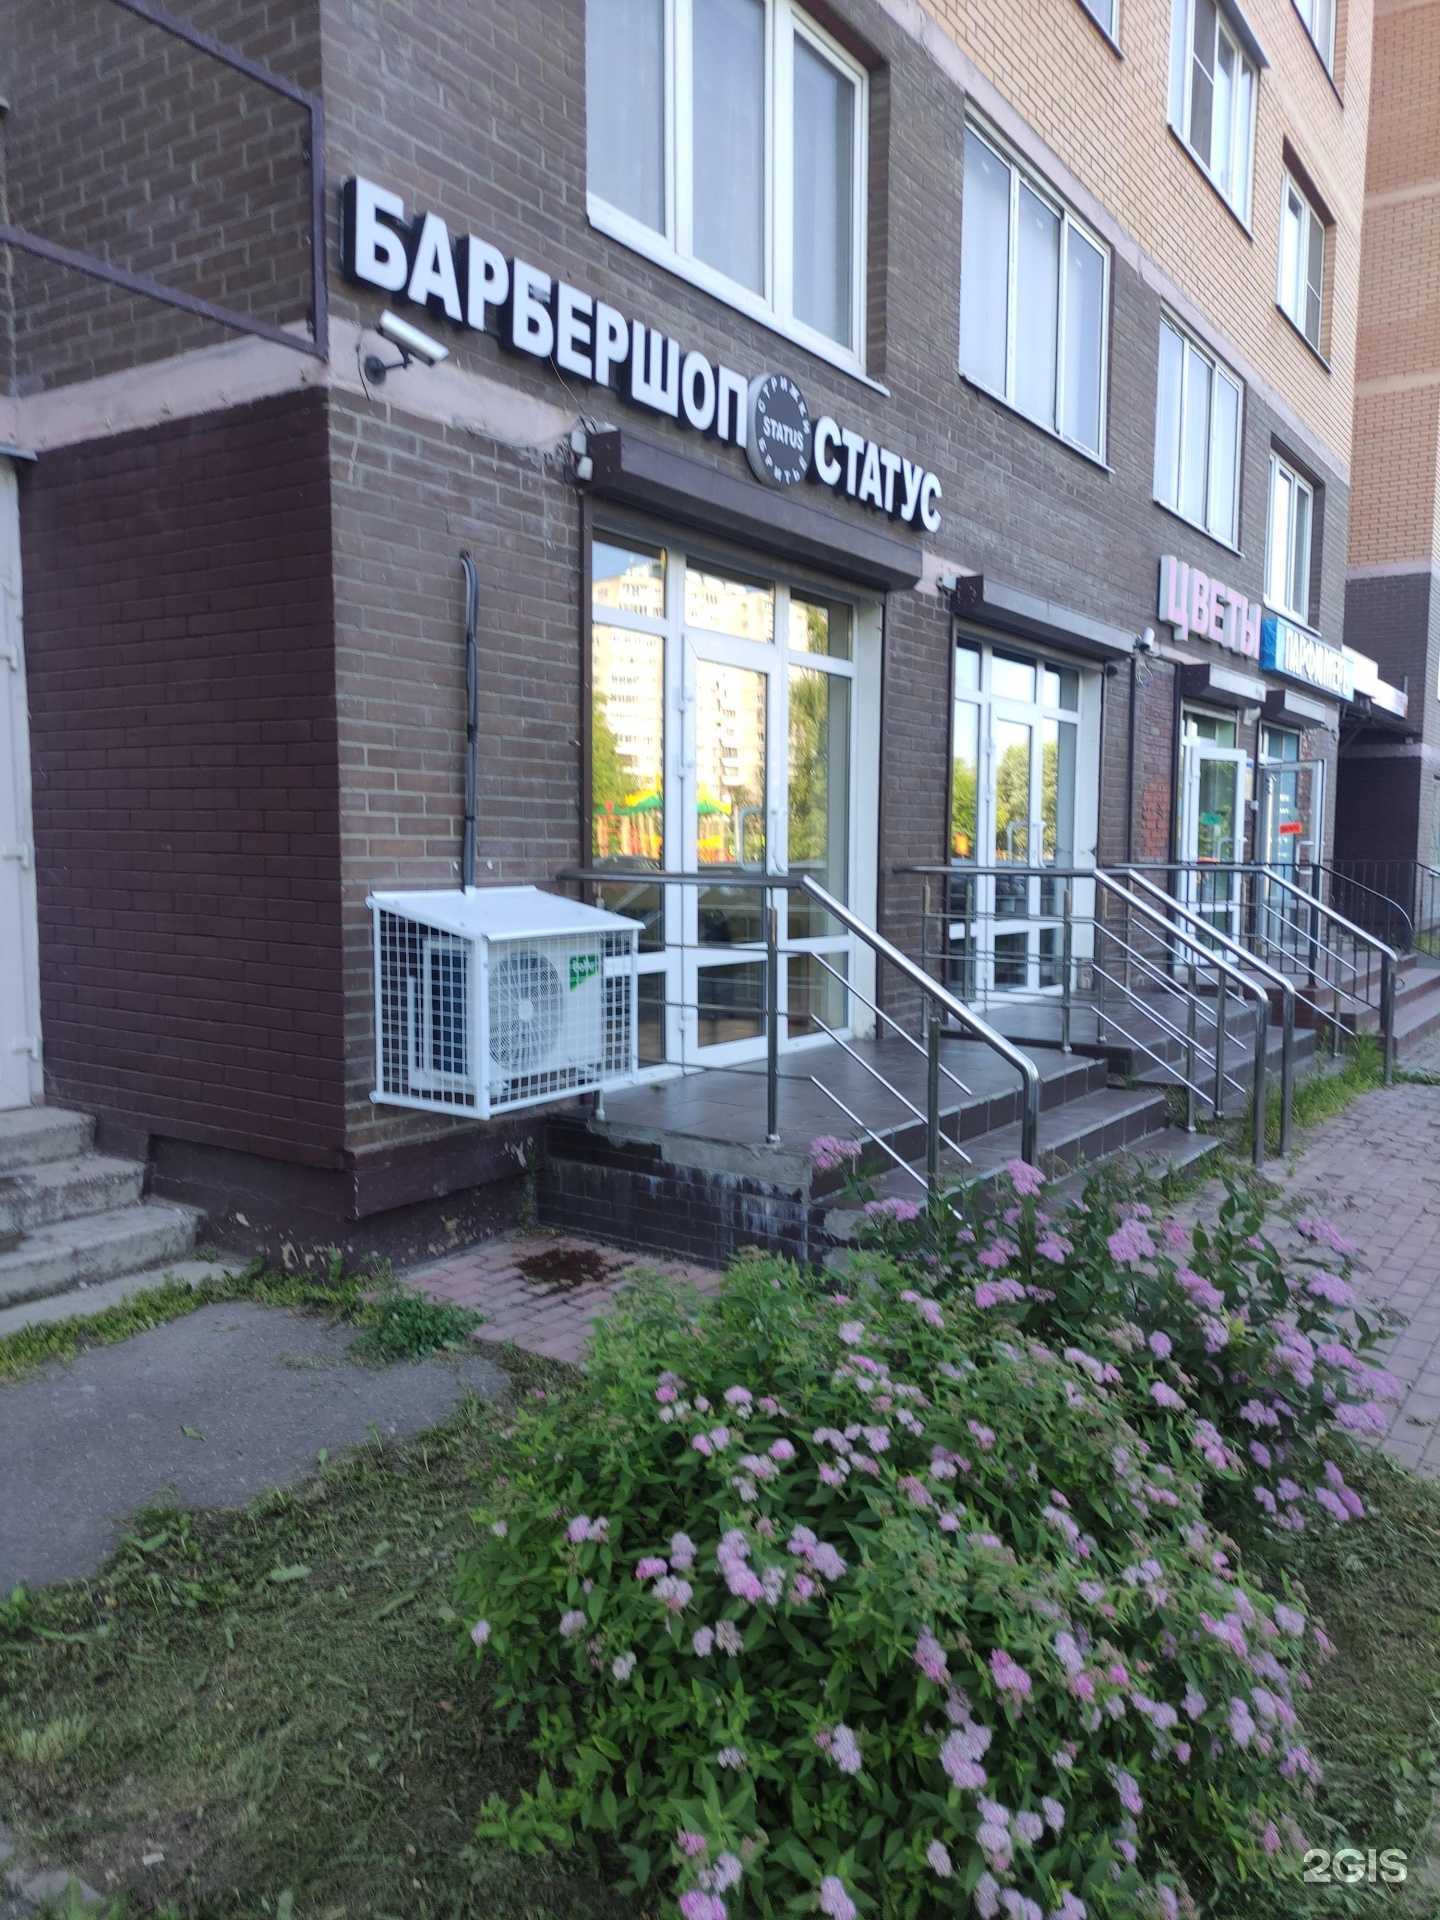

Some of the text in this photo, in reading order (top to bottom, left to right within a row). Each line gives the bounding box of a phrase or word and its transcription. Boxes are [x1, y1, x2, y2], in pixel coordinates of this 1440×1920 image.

[353, 175, 749, 449] БАРБЕРШОП
[763, 416, 804, 452] STATUS
[813, 415, 943, 533] СТАТУС
[1160, 554, 1263, 661] ЦВЕТЫ
